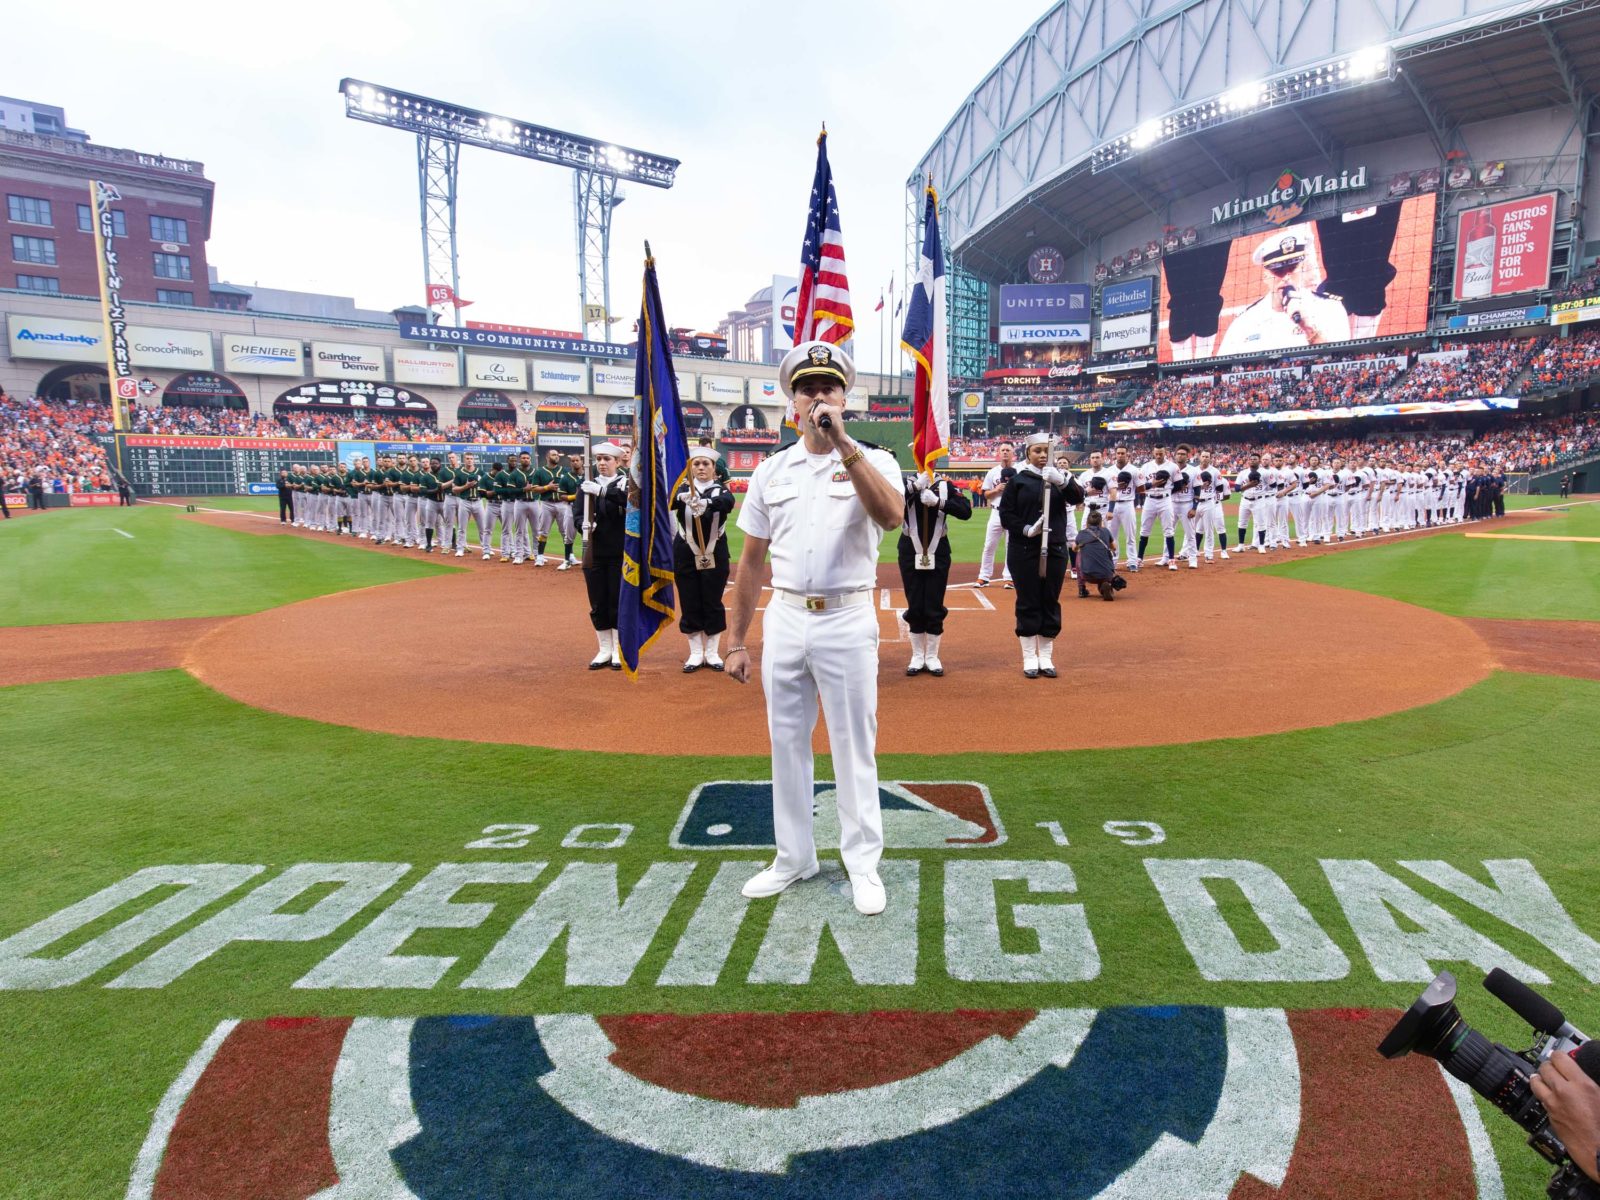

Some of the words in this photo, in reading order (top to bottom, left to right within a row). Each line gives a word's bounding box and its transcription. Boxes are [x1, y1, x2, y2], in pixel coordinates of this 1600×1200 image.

[1211, 187, 1294, 224] Minute
[1298, 166, 1367, 198] Maid
[1503, 204, 1548, 222] ASTROS
[1502, 220, 1534, 234] FANS,
[1501, 232, 1527, 246] THIS
[1500, 242, 1535, 257] BUD'S
[1040, 258, 1053, 271] H
[1499, 256, 1521, 269] FOR
[1498, 267, 1524, 280] YOU.
[432, 288, 448, 300] 05
[1105, 289, 1147, 306] Methodist
[1586, 295, 1600, 306] PM
[111, 293, 124, 318] IZ
[1006, 299, 1066, 308] UNITED
[589, 308, 601, 318] 17
[1480, 308, 1526, 321] CHAMPION
[17, 328, 99, 346] Anadarko
[478, 323, 531, 333] MINUTE
[543, 330, 573, 338] MAID
[1022, 328, 1082, 338] HONDA
[1102, 326, 1148, 341] AmegyBank
[410, 326, 470, 341] ASTROS
[476, 332, 566, 350] COMMUNITY
[572, 343, 629, 356] LEADERS
[113, 322, 129, 375] FARE
[135, 343, 204, 358] ConocoPhillips
[231, 344, 296, 357] CHENIERE
[318, 351, 362, 362] Gardner
[397, 358, 454, 368] HALLIBURTON
[342, 361, 380, 372] Denver
[475, 374, 519, 384] LEXUS
[540, 370, 581, 383] Schlumberger
[605, 374, 636, 382] CHAMPIO
[1121, 487, 1131, 495] 23
[5, 495, 27, 504] RGO
[463, 822, 635, 850] 20
[1034, 820, 1166, 848] 19
[0, 859, 1102, 991] OPENING
[1141, 857, 1600, 986] DAY
